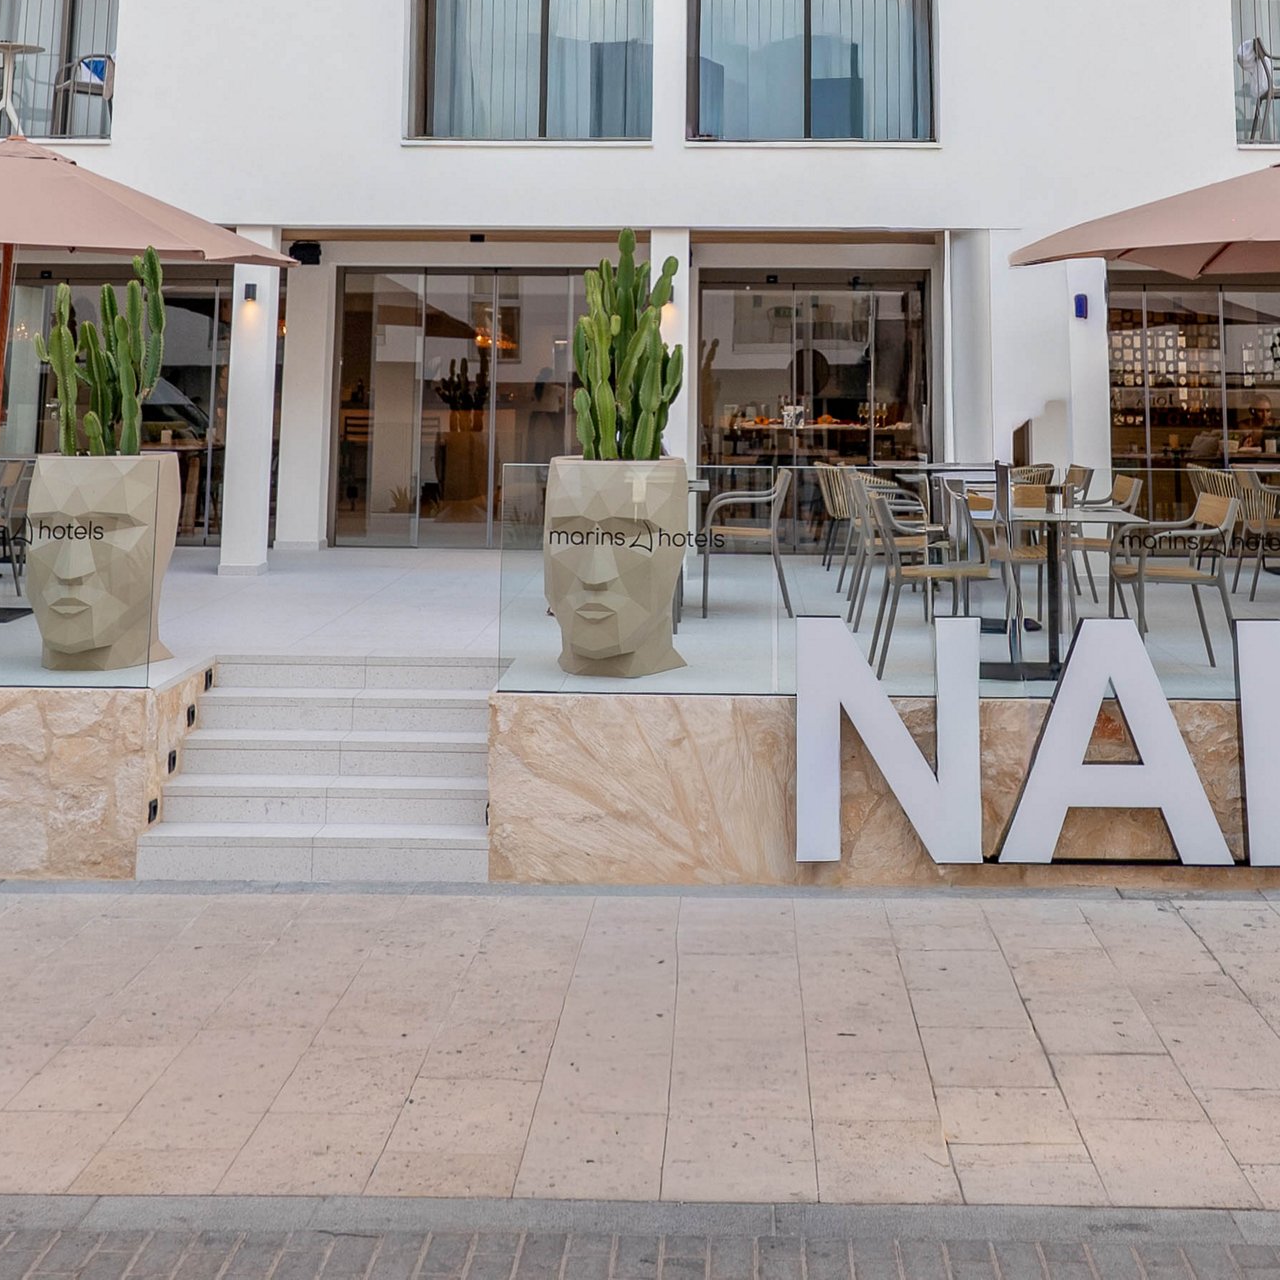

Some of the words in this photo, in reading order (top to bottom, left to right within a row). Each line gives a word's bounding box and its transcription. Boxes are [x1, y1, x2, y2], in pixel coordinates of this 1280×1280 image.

[38, 521, 105, 540] hotels
[549, 527, 626, 547] marins
[658, 527, 726, 548] hotels
[1121, 530, 1199, 551] marins
